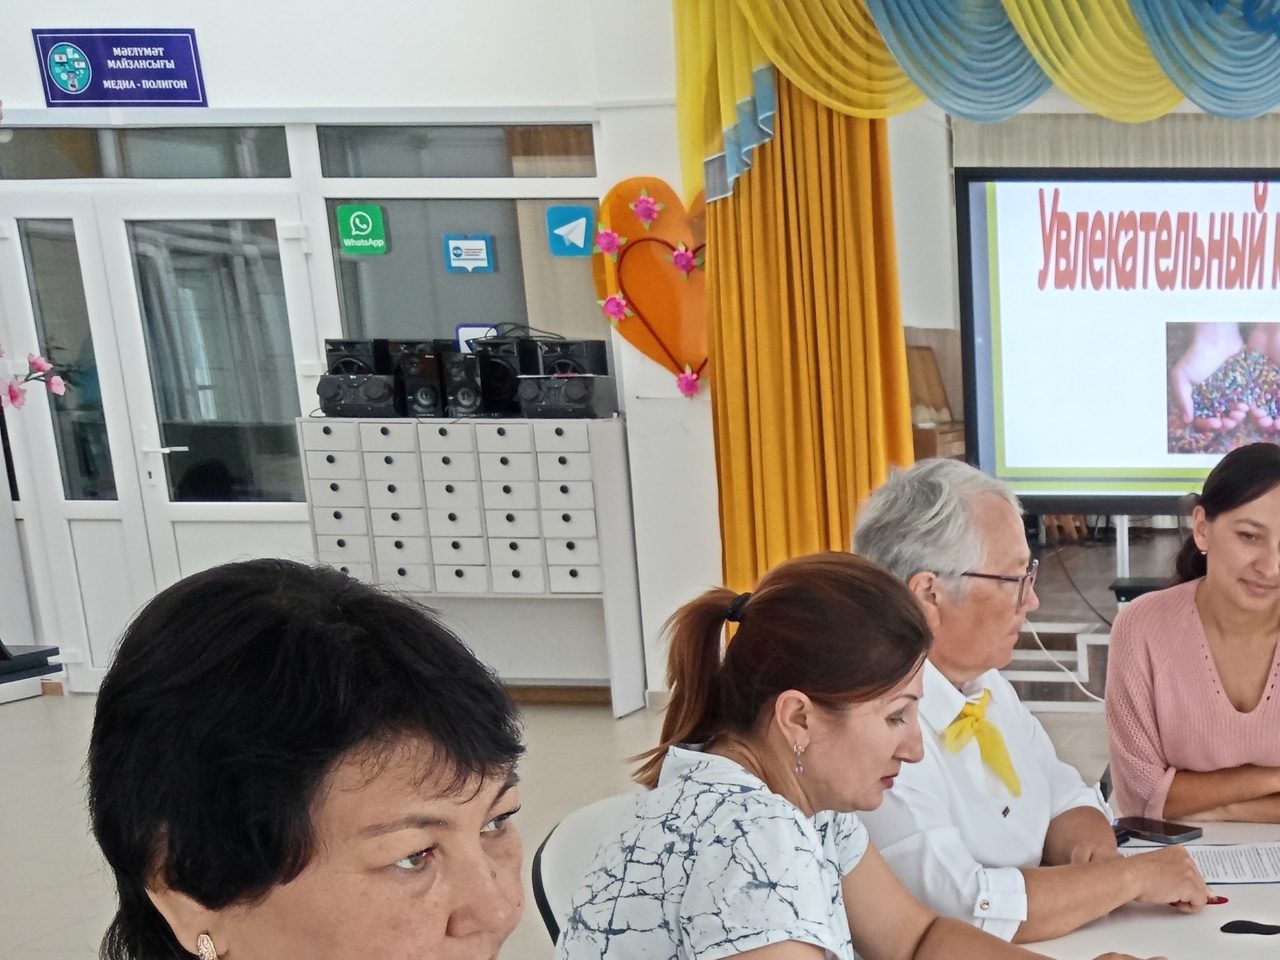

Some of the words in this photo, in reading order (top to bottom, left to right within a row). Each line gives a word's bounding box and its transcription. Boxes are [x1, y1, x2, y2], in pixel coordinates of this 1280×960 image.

[103, 79, 136, 90] МЕДИА
[142, 79, 188, 89] ПОЛИГОН
[1037, 180, 1270, 291] Увлекательный
[343, 238, 384, 248] WhatsApp
